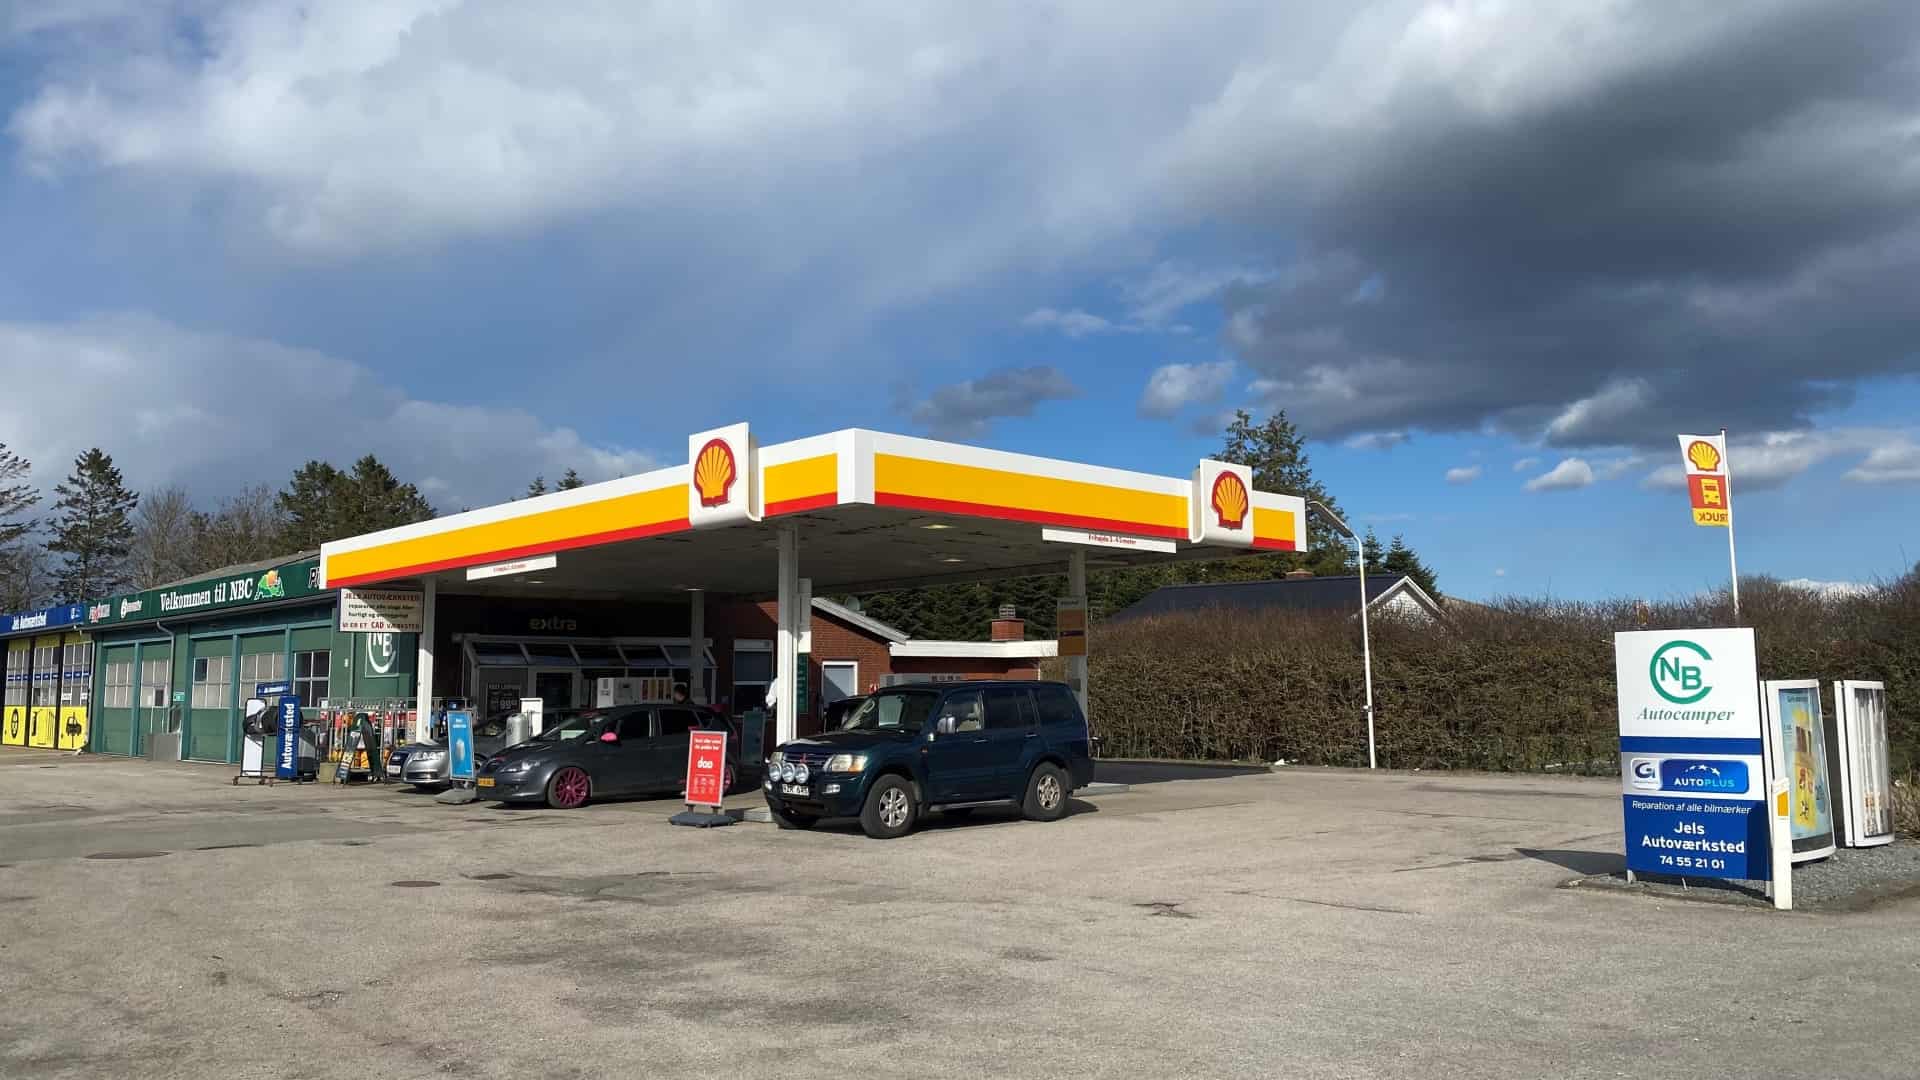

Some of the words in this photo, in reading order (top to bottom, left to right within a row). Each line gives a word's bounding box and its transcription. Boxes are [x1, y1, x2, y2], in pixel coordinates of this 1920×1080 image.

[160, 590, 211, 611] Velkommen
[214, 584, 226, 602] til
[230, 578, 253, 600] NBC
[371, 621, 385, 629] CAD
[529, 616, 577, 631] extra
[1638, 708, 1735, 724] Autocamper
[1673, 777, 1735, 788] AUTOPLUS
[1632, 800, 1675, 811] Reparation
[1675, 803, 1685, 812] af
[1686, 803, 1703, 813] alle
[1704, 804, 1752, 815] bilmærker
[1674, 822, 1705, 834] Jels
[1642, 836, 1744, 853] Autoværksted
[1660, 856, 1673, 866] 74
[1676, 857, 1692, 867] 55
[1695, 858, 1708, 868] 21
[1711, 859, 1725, 869] 01
